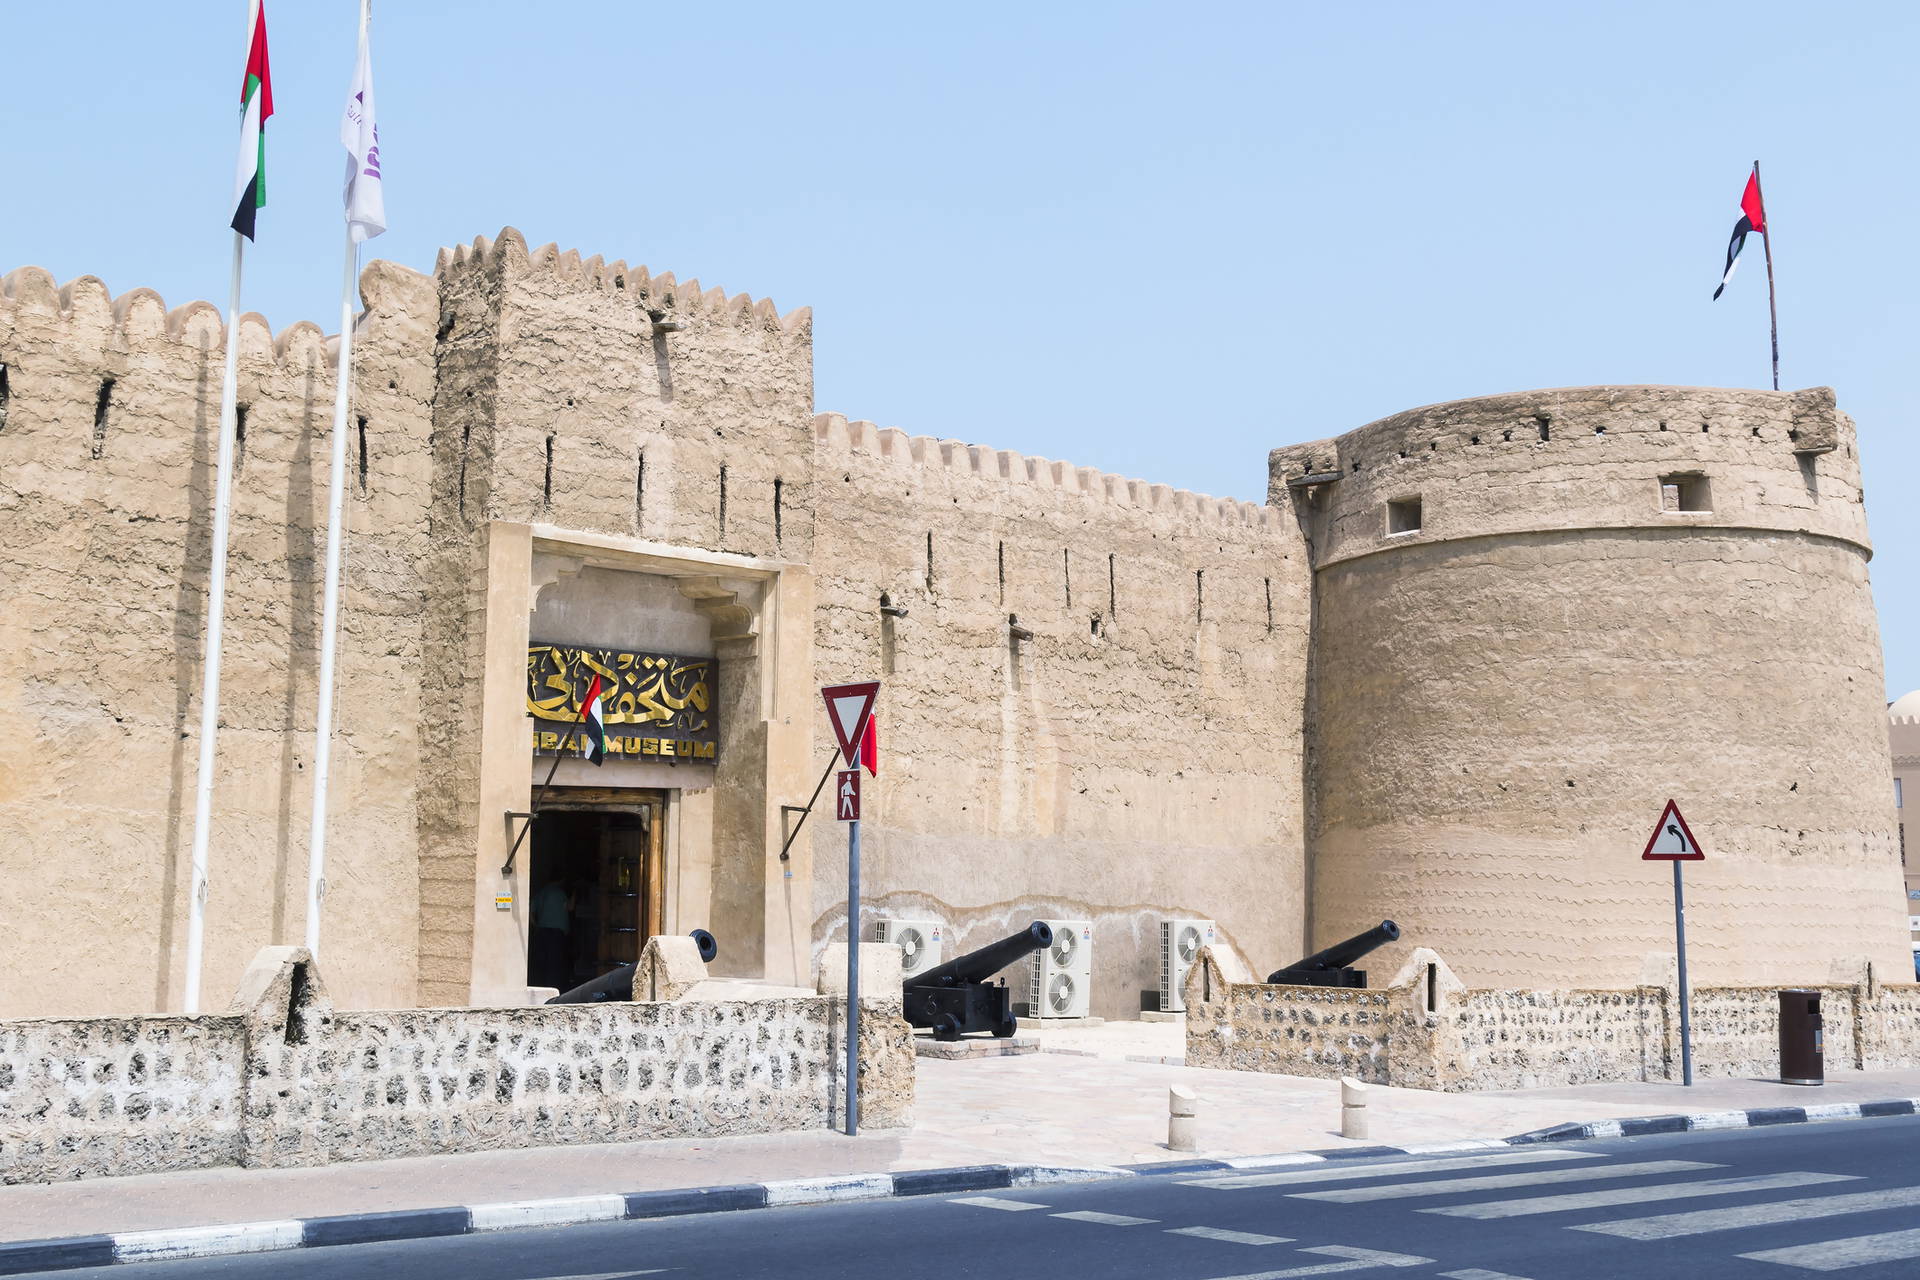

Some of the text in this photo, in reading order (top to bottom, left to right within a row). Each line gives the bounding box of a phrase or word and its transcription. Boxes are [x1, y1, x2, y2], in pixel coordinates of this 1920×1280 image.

[528, 647, 711, 724] متحف دبي
[533, 731, 715, 758] BAI MUSEUM
